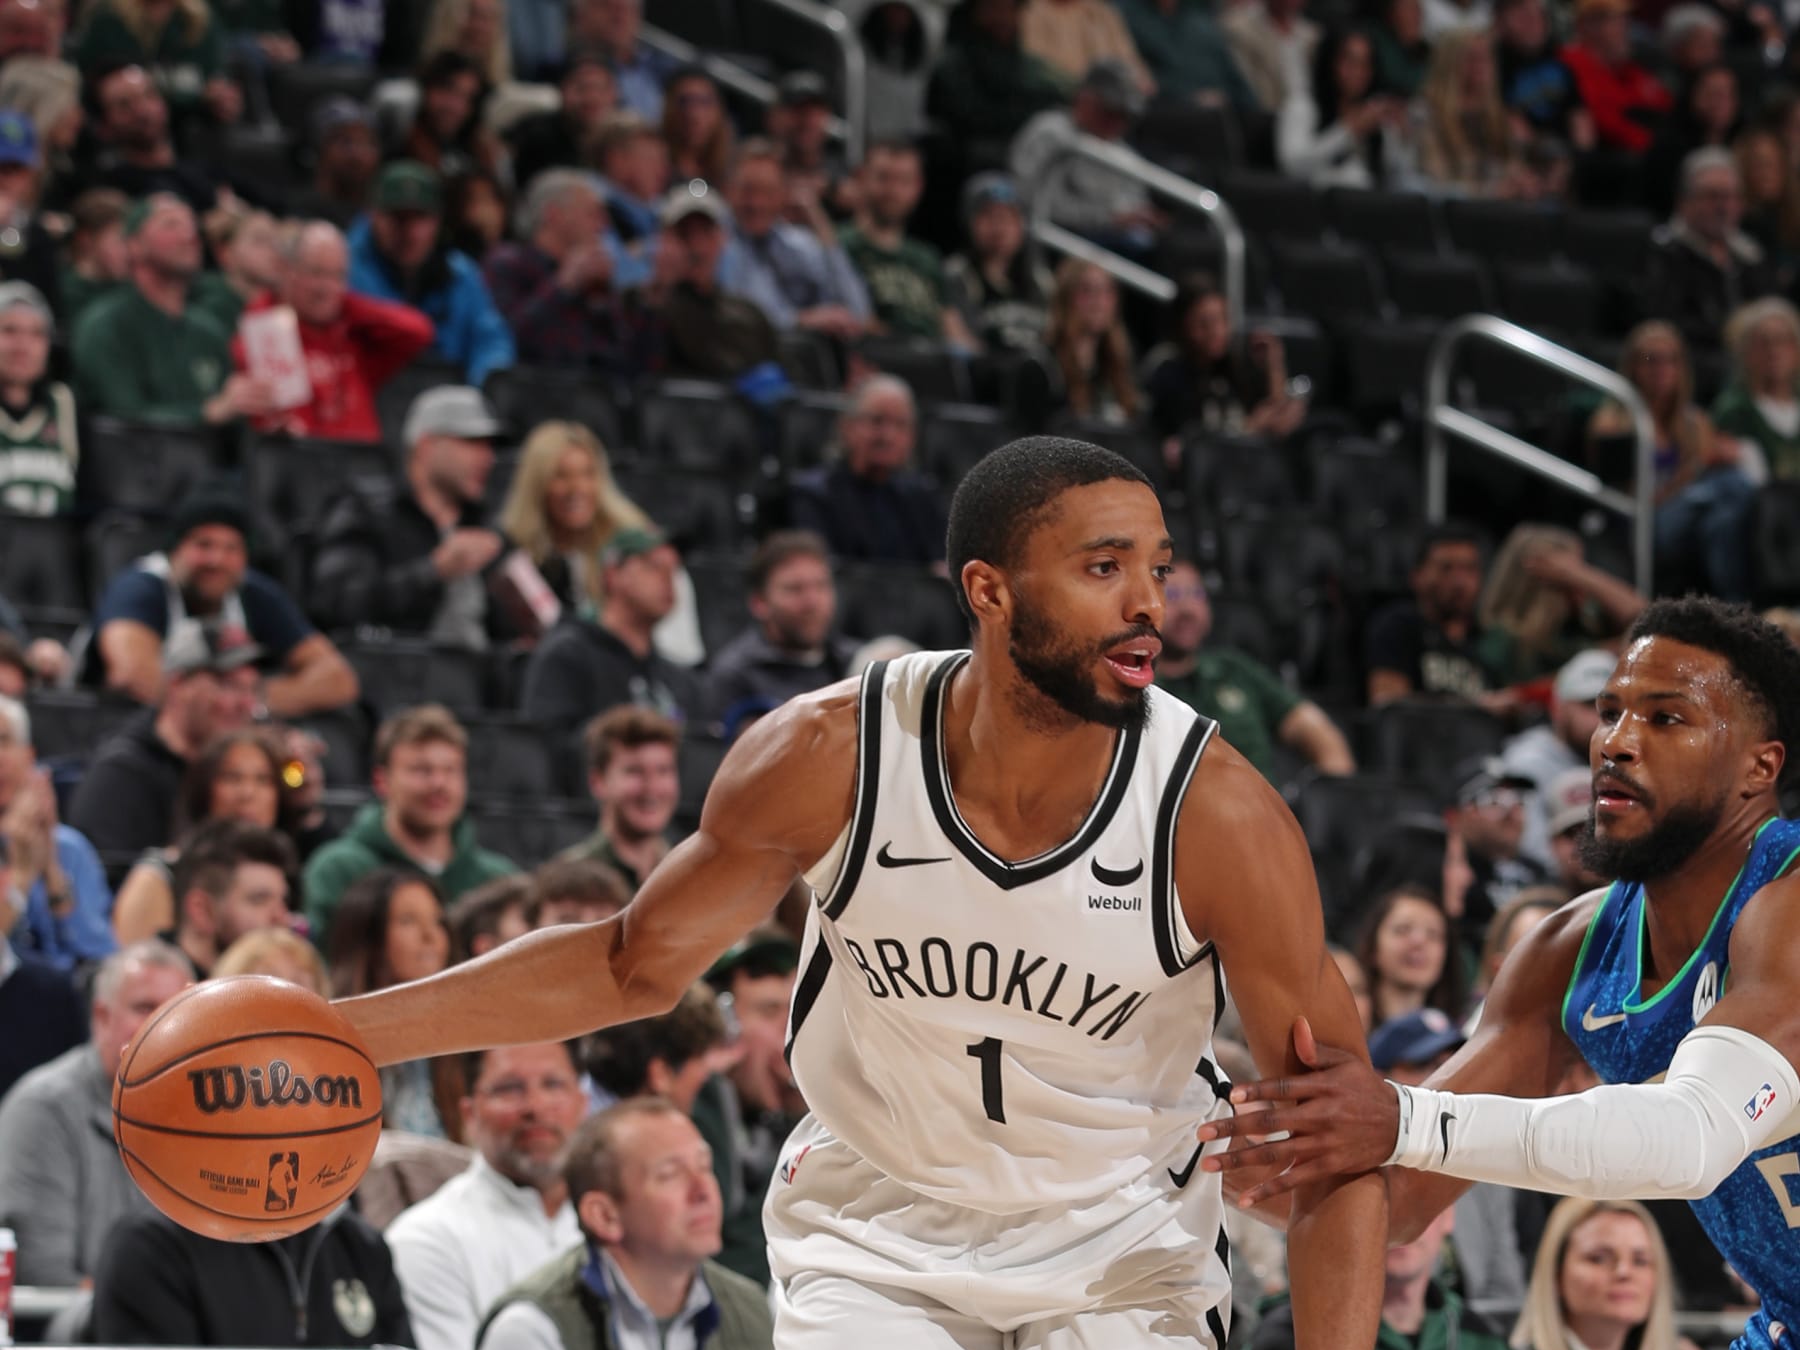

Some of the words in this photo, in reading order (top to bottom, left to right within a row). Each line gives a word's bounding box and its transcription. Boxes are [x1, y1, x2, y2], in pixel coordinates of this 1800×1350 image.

[1087, 895, 1142, 912] Webull
[844, 936, 1153, 1041] BROOKLYN
[187, 1060, 362, 1114] Wilson
[966, 1035, 1007, 1125] 1
